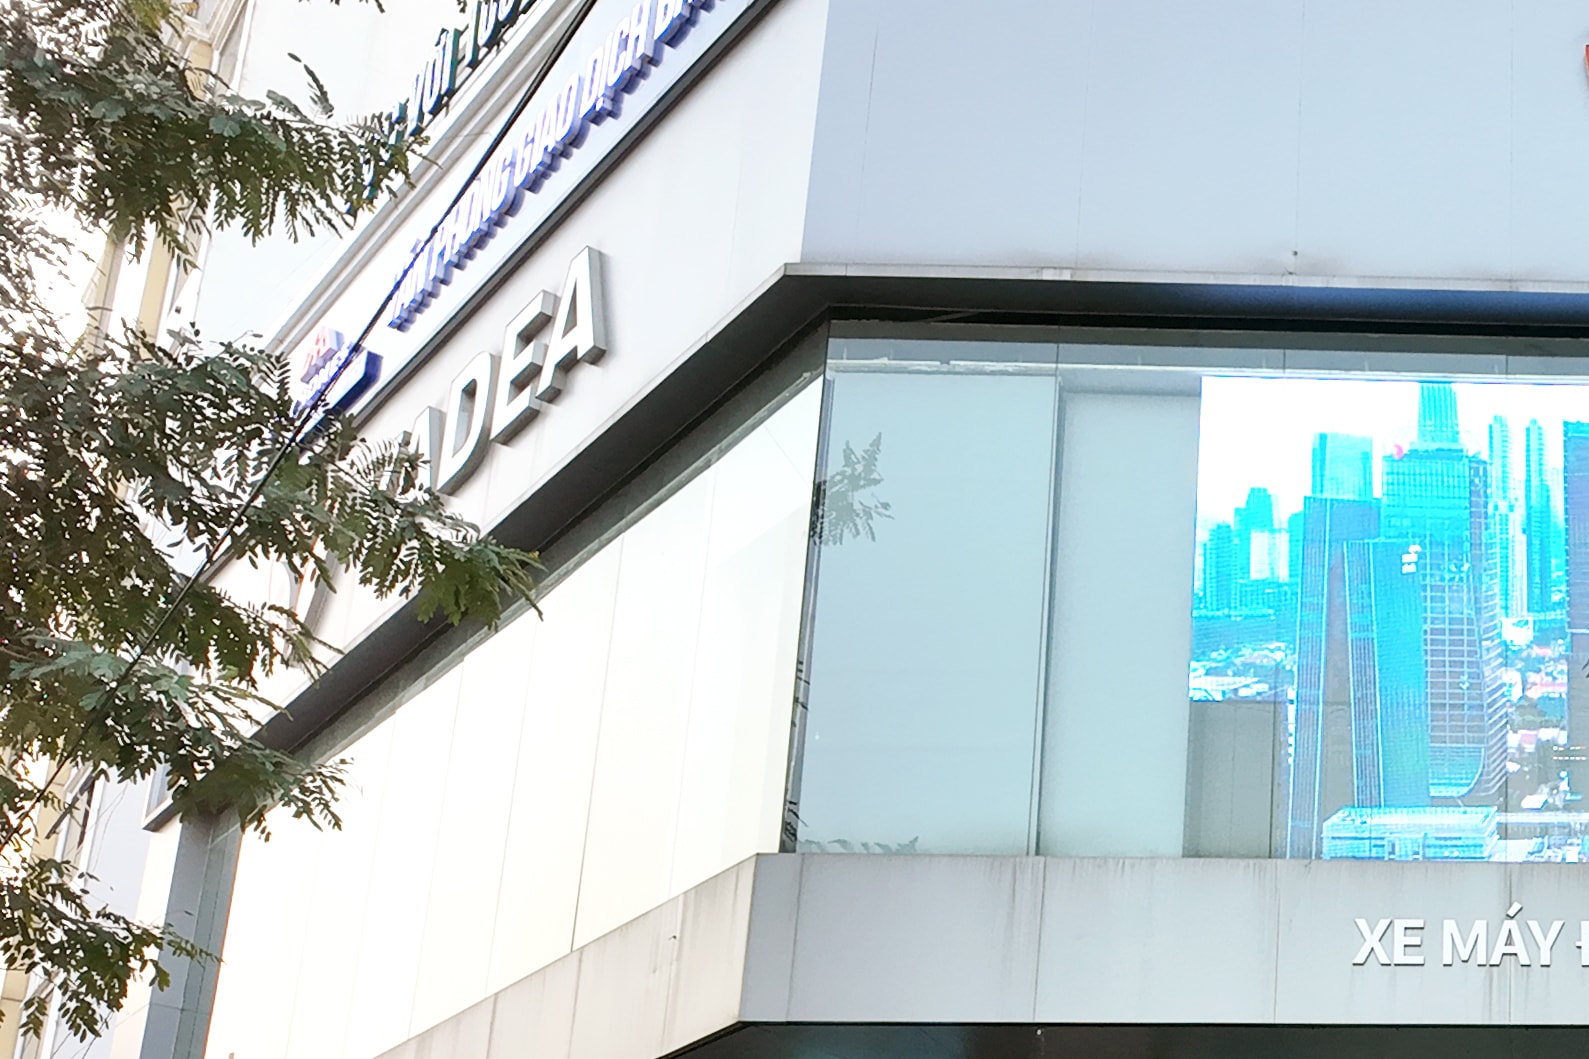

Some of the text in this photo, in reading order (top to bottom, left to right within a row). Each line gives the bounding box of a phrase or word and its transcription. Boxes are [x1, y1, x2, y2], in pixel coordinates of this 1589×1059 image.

[512, 73, 584, 189] GIAO
[578, 0, 653, 118] DỊCH
[376, 245, 606, 500] ADEA
[1352, 917, 1426, 966] XE
[1440, 903, 1566, 968] MÁY
